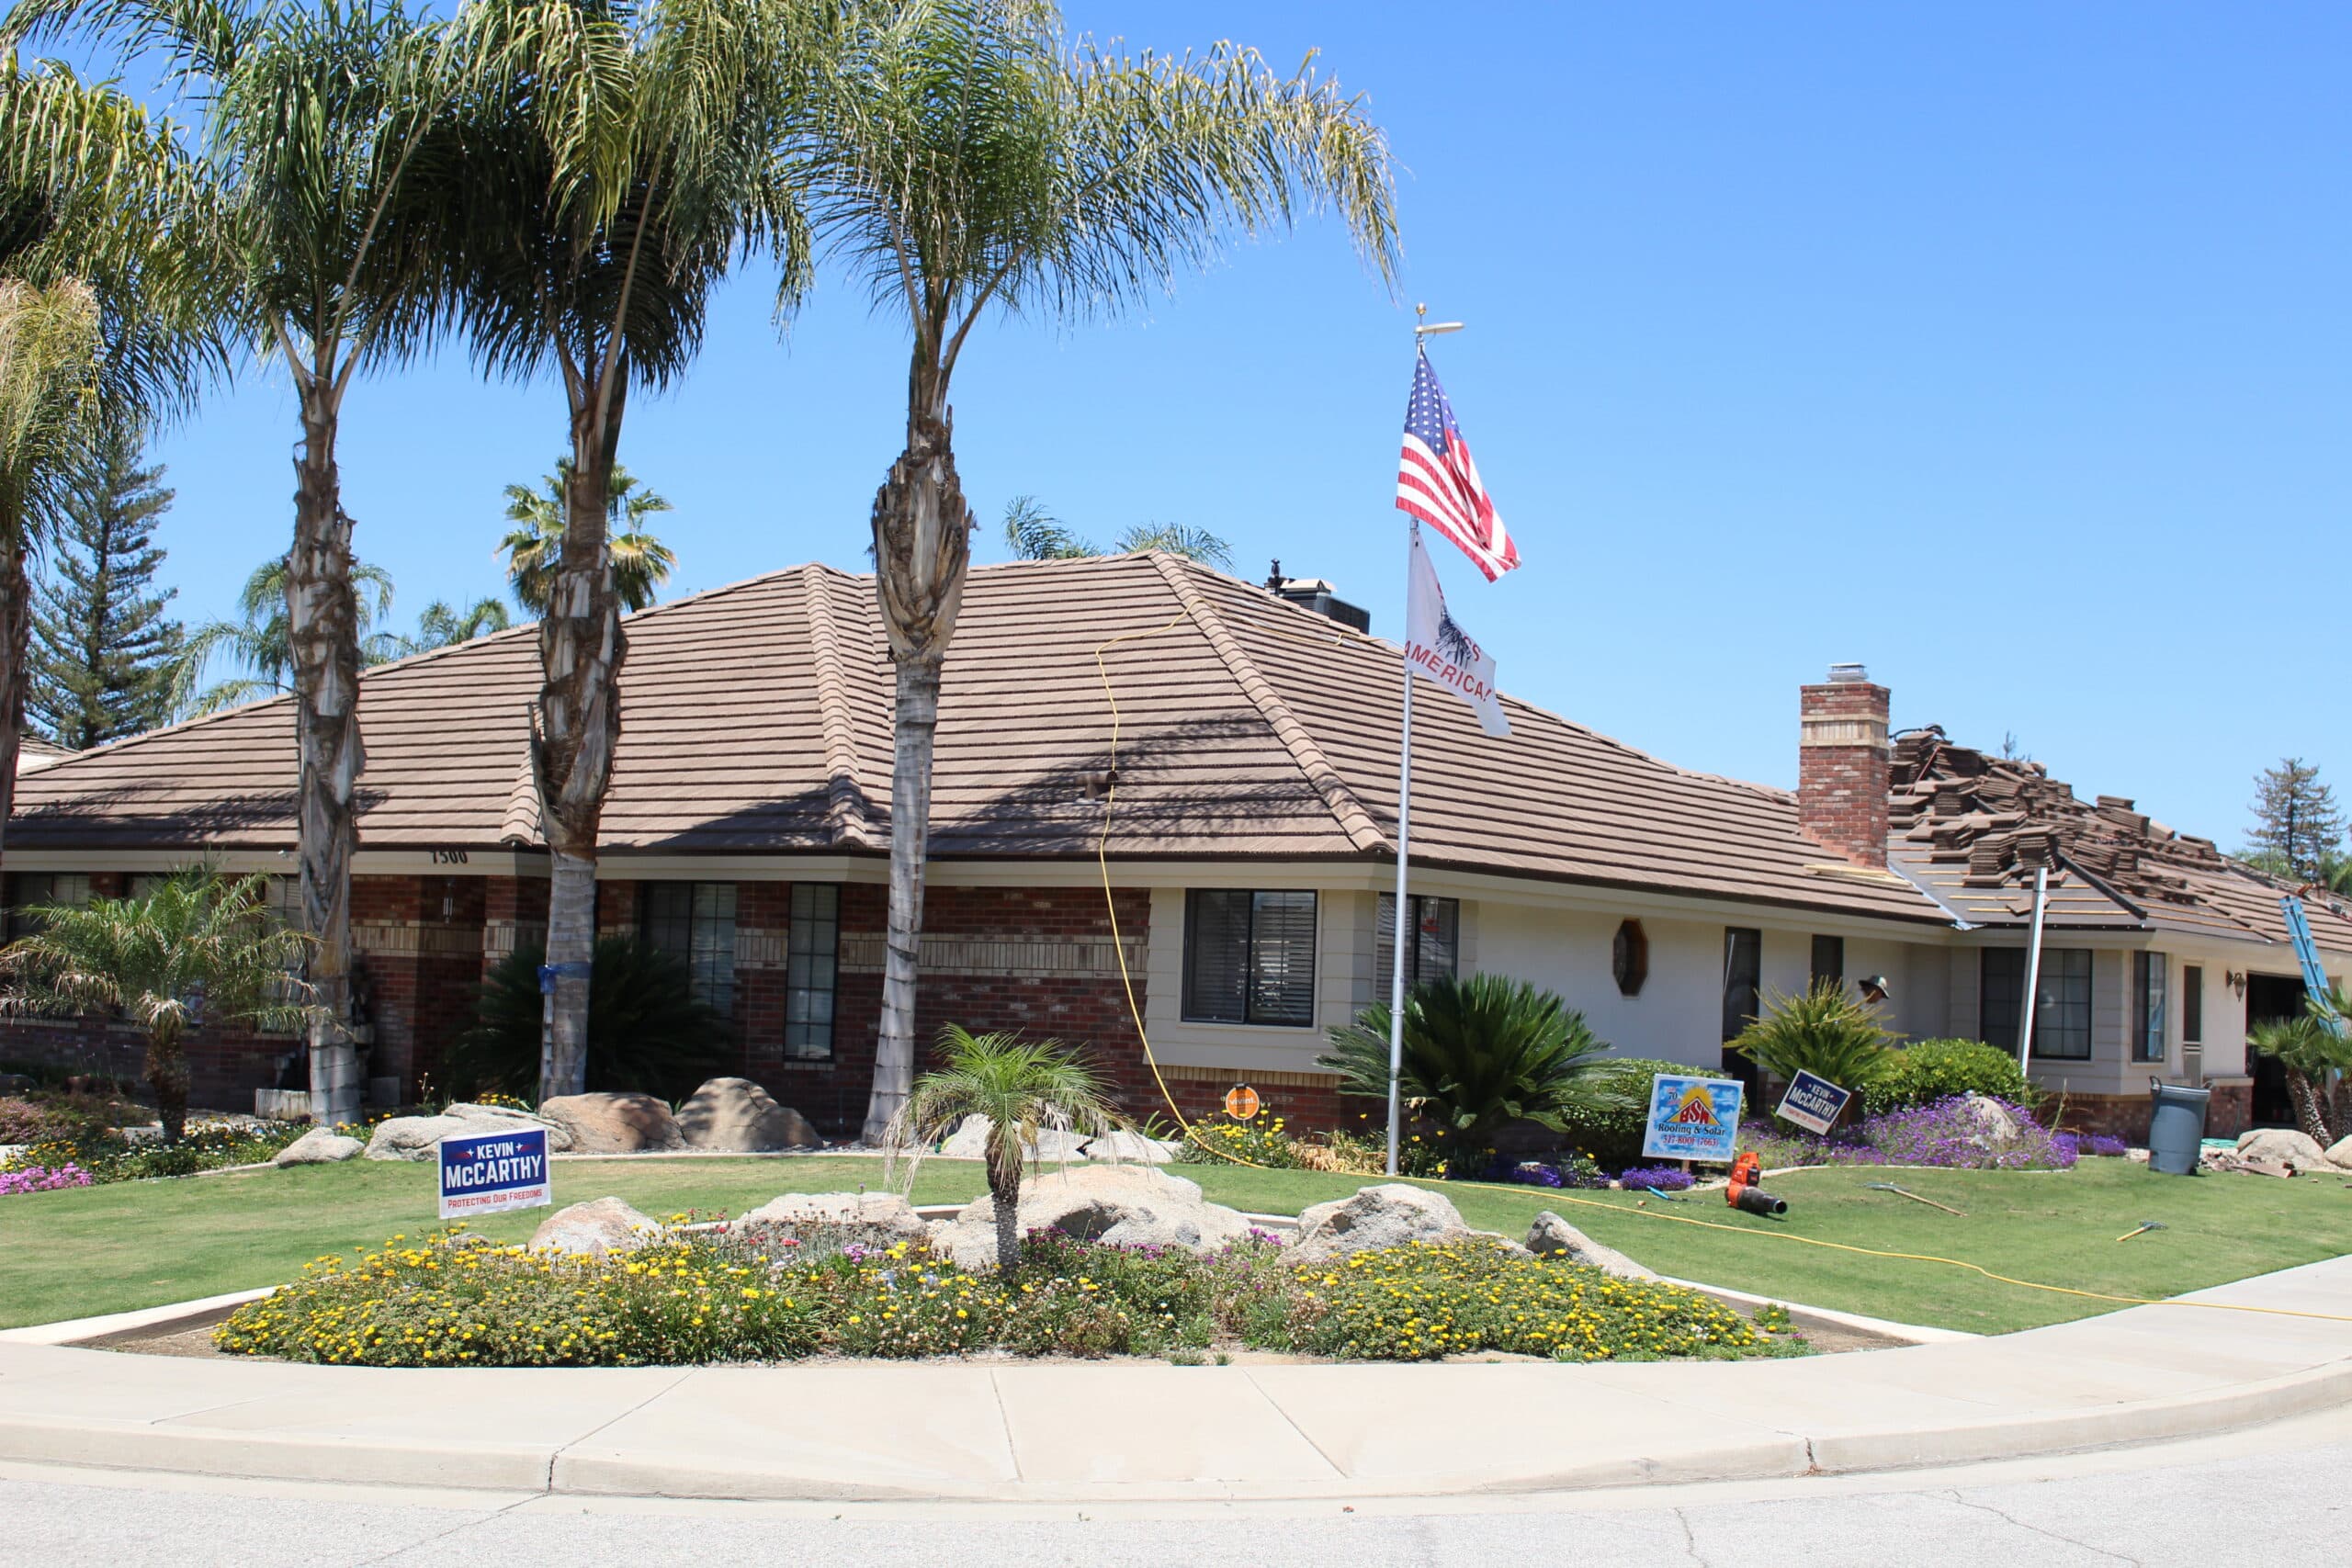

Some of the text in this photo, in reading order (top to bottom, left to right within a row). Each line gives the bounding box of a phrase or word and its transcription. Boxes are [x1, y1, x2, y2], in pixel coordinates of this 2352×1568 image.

[1405, 640, 1492, 702] AMERICA!
[1658, 1123, 1726, 1136] Roofing & Solar
[477, 1142, 514, 1159] KEVIN
[447, 1196, 492, 1209] PROTECTING
[493, 1193, 507, 1203] OUR
[509, 1189, 543, 1201] FREEDOMS
